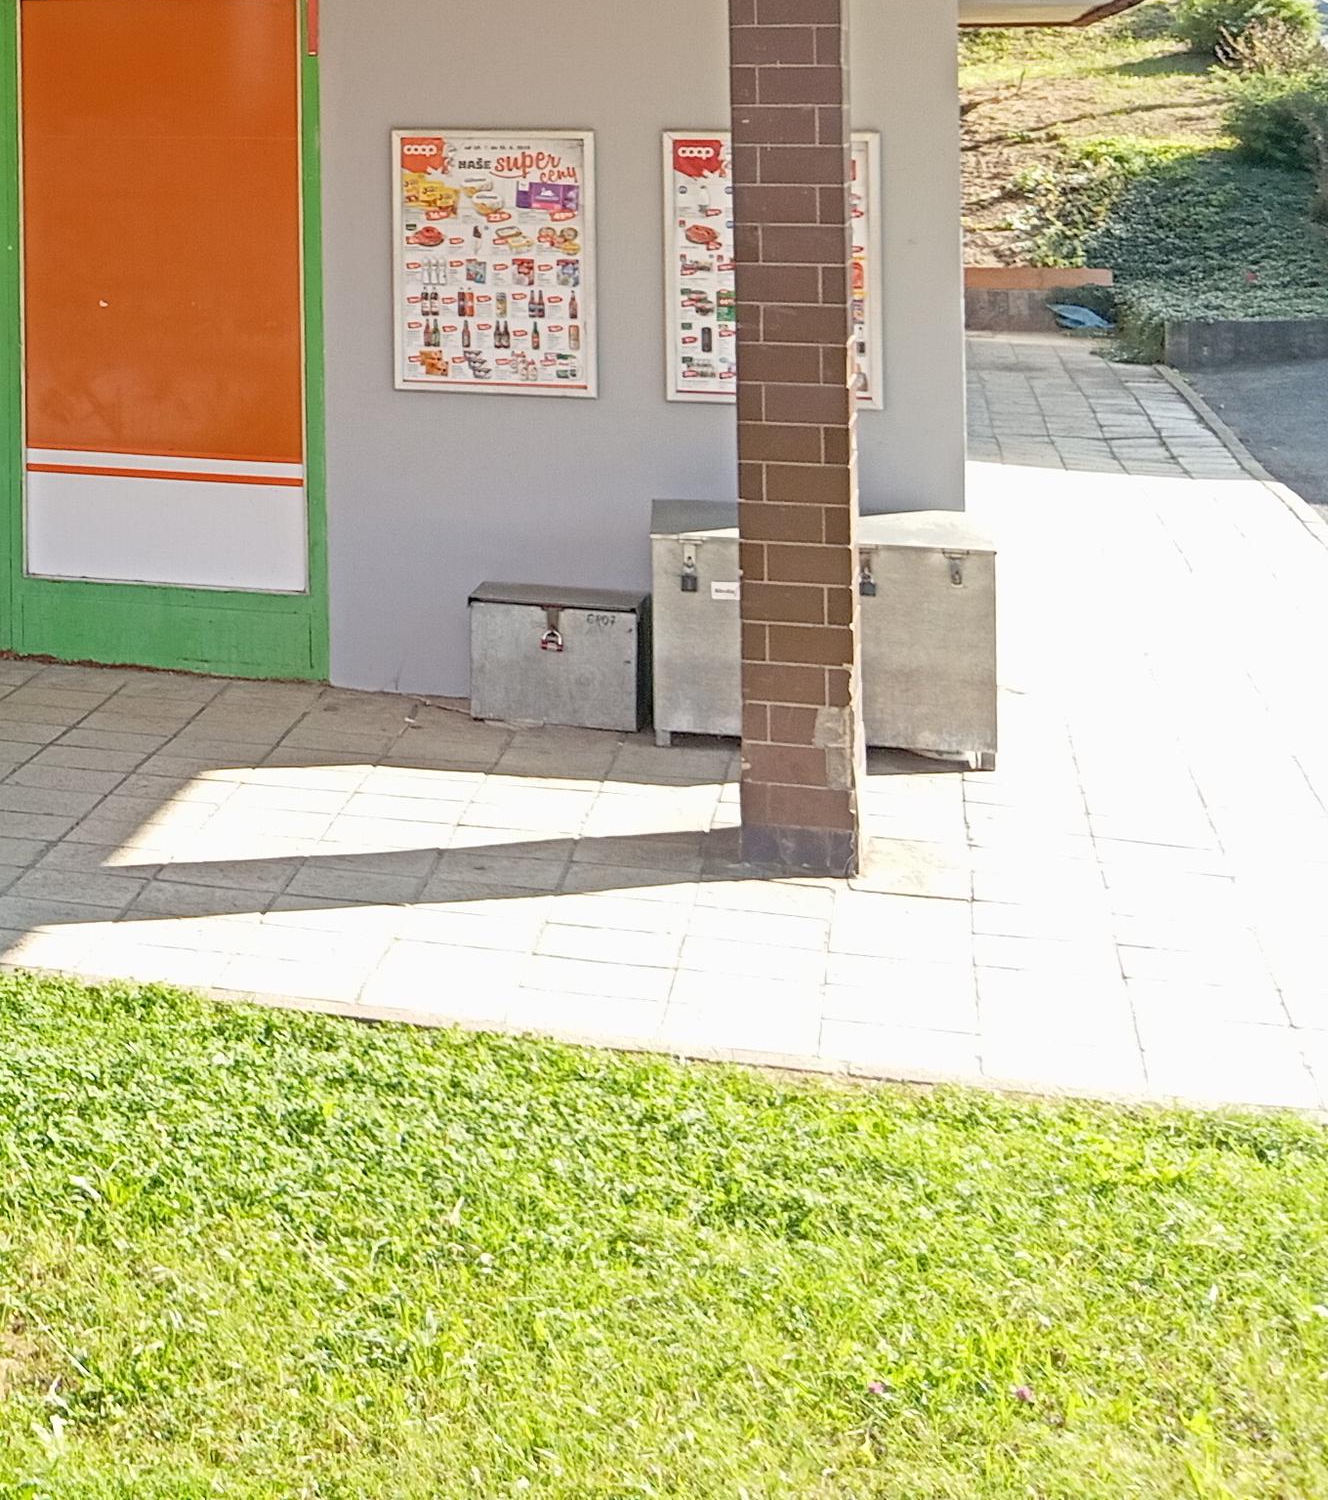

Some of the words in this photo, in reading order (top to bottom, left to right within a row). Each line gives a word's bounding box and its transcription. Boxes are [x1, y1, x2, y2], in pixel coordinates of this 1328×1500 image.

[404, 144, 437, 157] coop
[677, 146, 715, 160] coop
[458, 158, 492, 170] NAŠE
[495, 151, 561, 178] super
[539, 166, 578, 183] ceny
